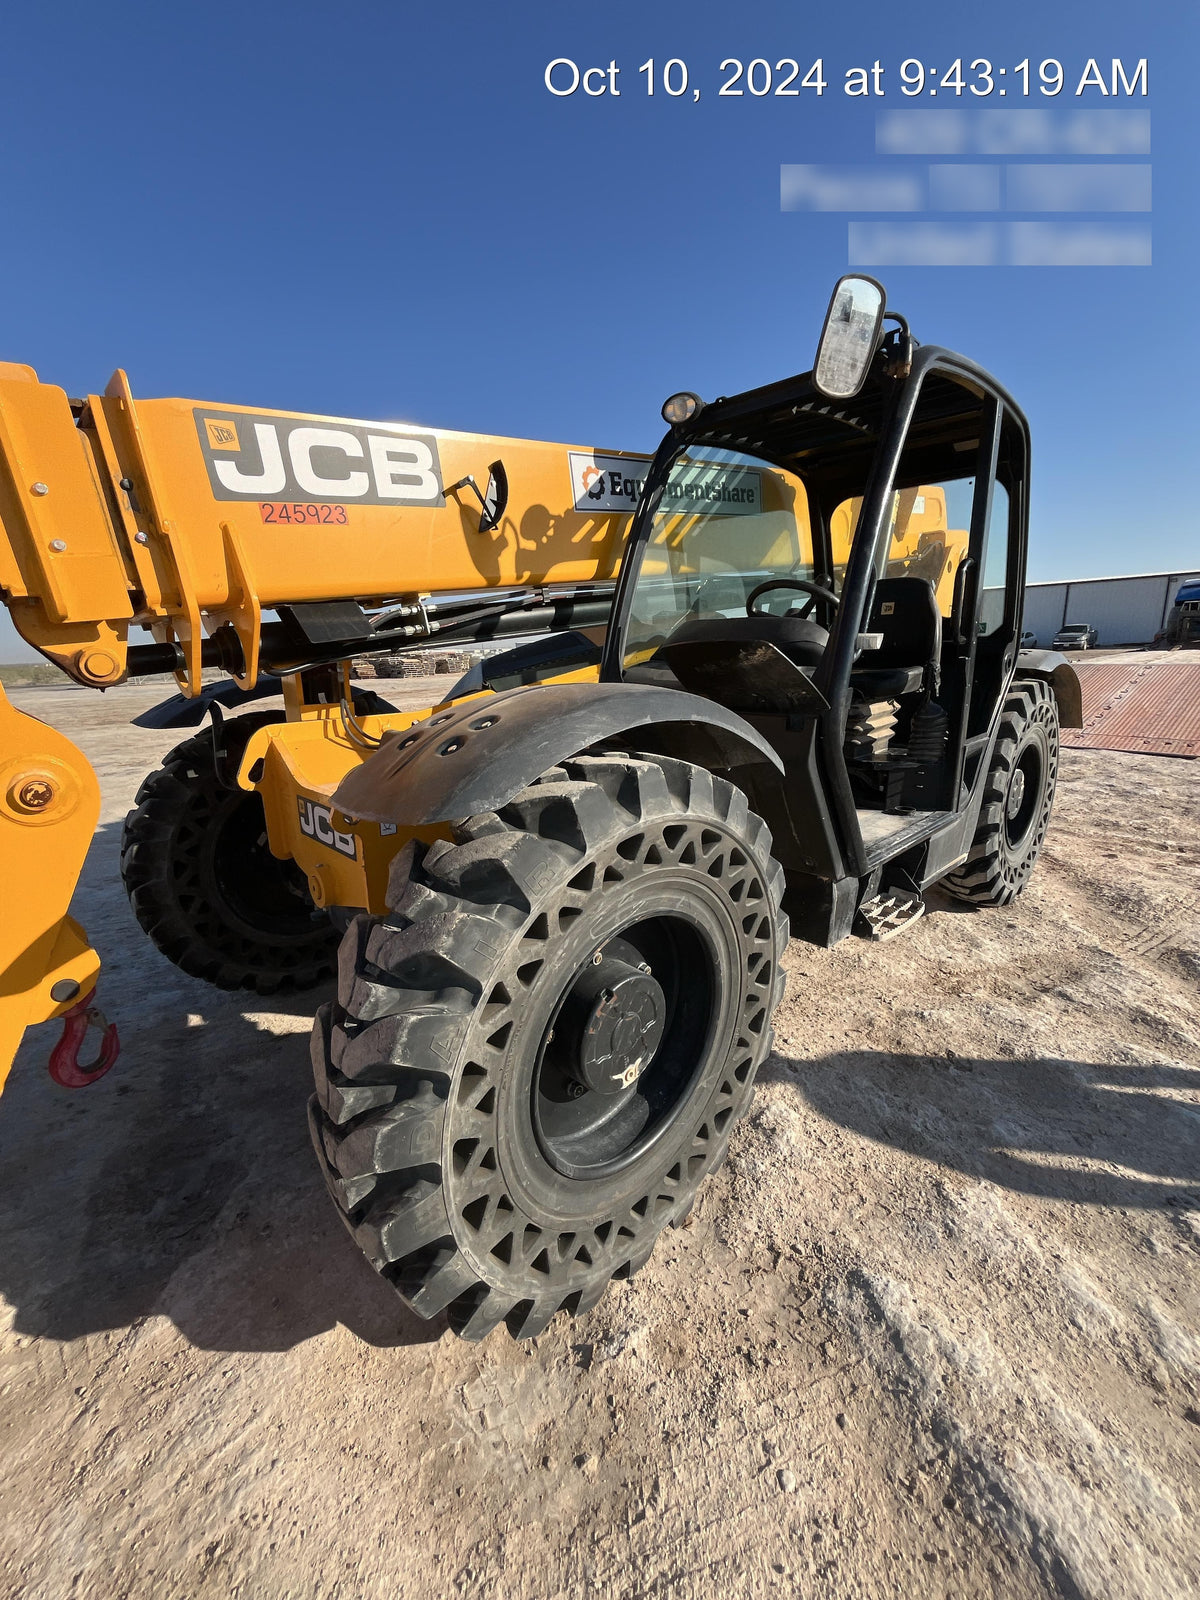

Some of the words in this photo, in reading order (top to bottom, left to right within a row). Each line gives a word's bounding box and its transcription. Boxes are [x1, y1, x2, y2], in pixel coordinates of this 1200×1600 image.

[210, 425, 235, 443] JCB
[214, 423, 439, 500] JCB
[608, 471, 755, 504] Equmentshare
[262, 503, 347, 524] 245923
